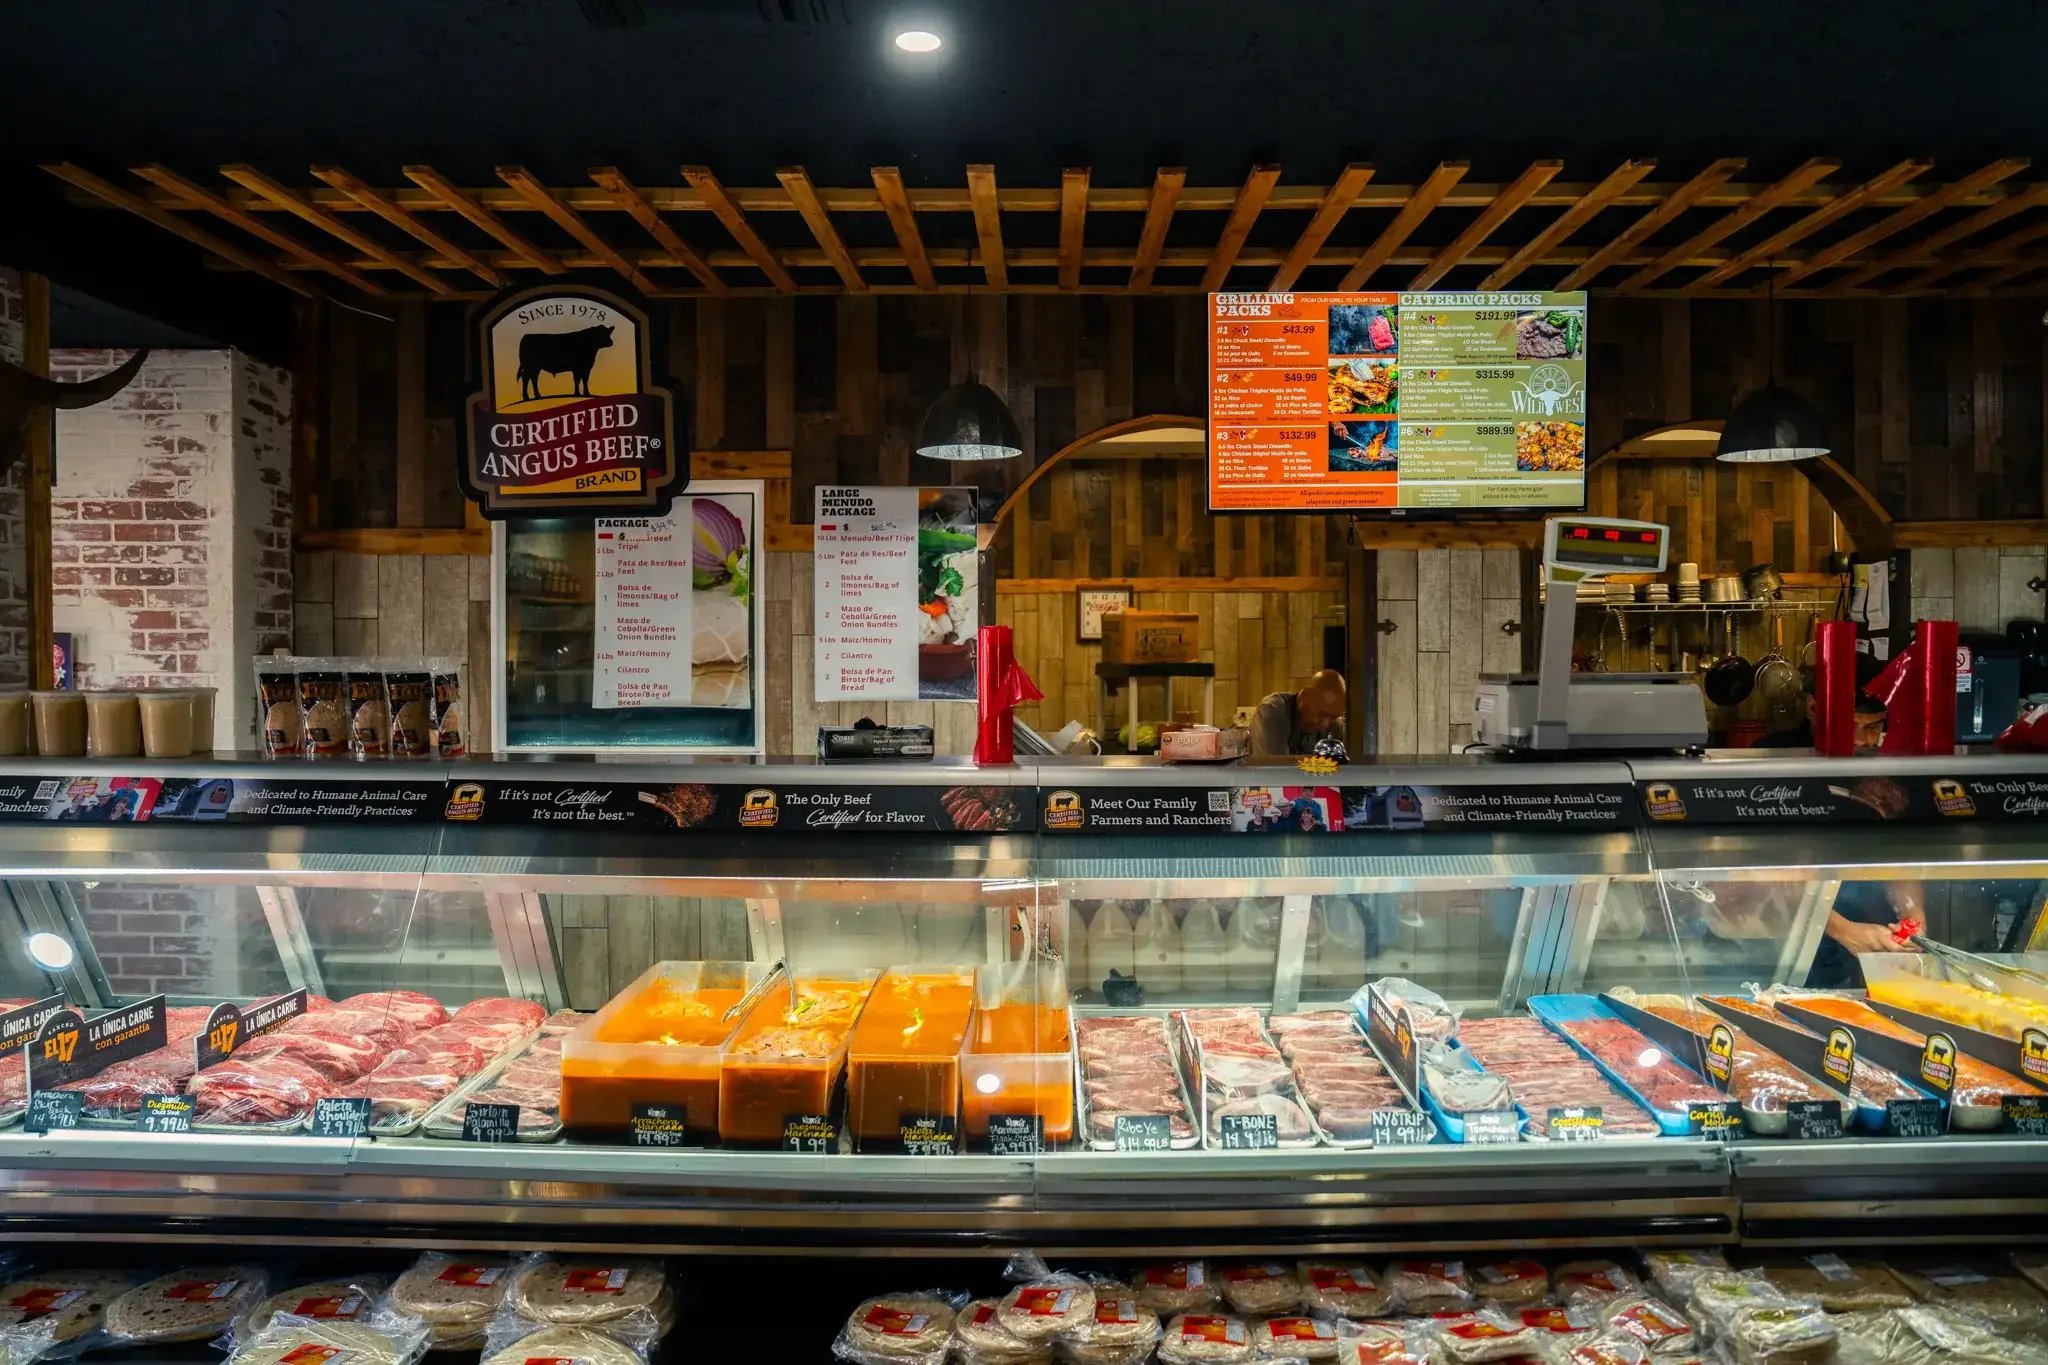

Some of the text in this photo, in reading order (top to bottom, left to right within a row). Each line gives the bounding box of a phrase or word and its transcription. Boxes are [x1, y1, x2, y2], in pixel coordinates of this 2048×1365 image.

[1216, 294, 1294, 305] GRILLING
[1400, 294, 1542, 305] CATERING PACKS
[519, 304, 607, 325] SINCE 1978
[1216, 305, 1271, 316] PACKS
[1404, 311, 1516, 320] #4 $191.99
[1217, 325, 1315, 334] #1 $43.99
[1216, 374, 1317, 382] #2 $49.99
[1401, 370, 1515, 379] #5 $315.99
[490, 404, 639, 448] CERTIFIED
[1401, 426, 1515, 436] #6 $989.99
[1216, 431, 1316, 440] #3 $132.99
[481, 444, 578, 478] ANGUS
[575, 470, 637, 490] BRAND
[822, 489, 860, 497] LARGE
[822, 499, 873, 507] MENUDO
[822, 508, 876, 516] PACKAGE
[598, 519, 649, 528] PACKAGE
[895, 535, 915, 543] Tripe
[618, 543, 639, 551] Tripe
[841, 582, 889, 590] limones/Bag
[617, 593, 668, 601] limones/Bag
[617, 650, 671, 658] Maiz/Hominy
[841, 676, 884, 684] Birote/Bag
[1176, 736, 1201, 746] POLY
[1971, 781, 2048, 794] The Only Bee
[243, 789, 427, 801] Dedicated to Humane Animal Care
[499, 788, 613, 809] If it's not Certified
[1432, 793, 1622, 806] Dedicated to Humane Animal Care
[1693, 785, 1802, 804] If it's not Certified
[785, 794, 871, 807] The Only Beef
[1091, 798, 1197, 811] Meet Our Family
[247, 805, 268, 815] and
[270, 805, 361, 818] Climate-Friendly
[1443, 812, 1465, 822] and
[1467, 810, 1563, 822] Climate-Friendly
[806, 808, 925, 829] Certified for Flavor
[1091, 814, 1232, 825] Farmers and Ranchers
[246, 998, 298, 1033] LA ÚNICA CARNE
[90, 1006, 154, 1042] LA ÚNICA CARNE
[95, 1023, 150, 1050] con garantía
[210, 1021, 238, 1053] EL 17
[45, 1030, 79, 1064] EL 17
[317, 1098, 352, 1112] Paleta
[1225, 1115, 1274, 1129] T-BONE
[900, 1126, 935, 1136] Paleta
